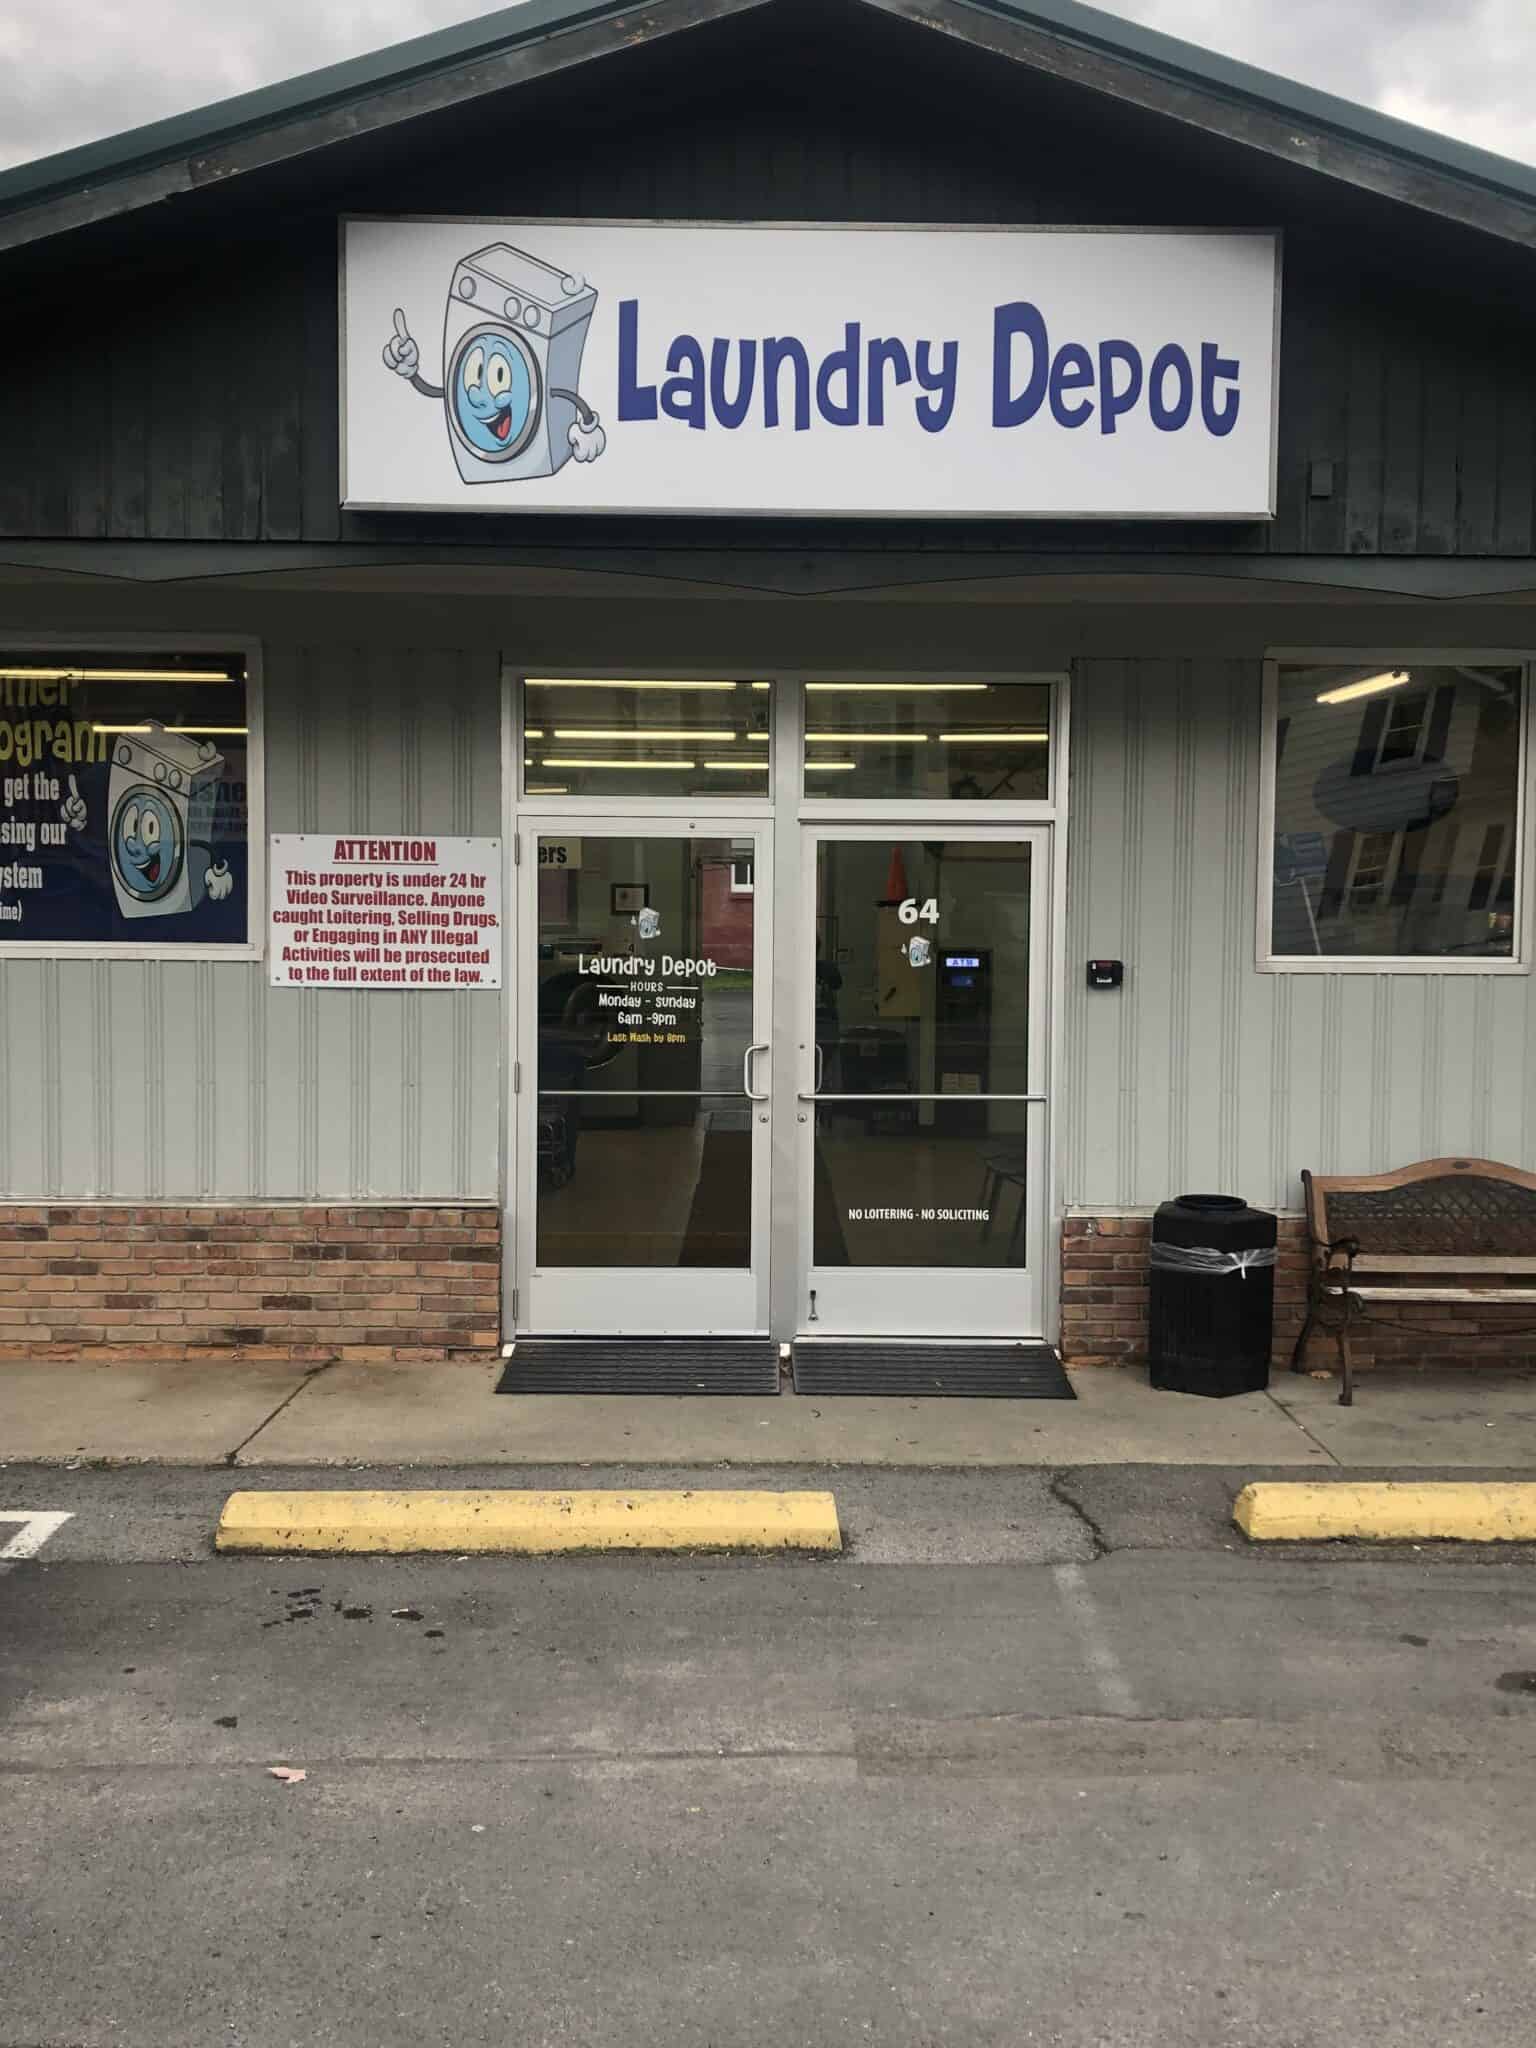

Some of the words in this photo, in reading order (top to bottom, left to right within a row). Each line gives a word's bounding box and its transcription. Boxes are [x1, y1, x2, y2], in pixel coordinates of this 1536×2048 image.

[618, 300, 958, 434] Laundry
[993, 301, 1241, 437] Depot
[0, 667, 79, 706] mer
[4, 773, 29, 807] get
[34, 771, 60, 800] the
[1, 816, 36, 851] sing
[40, 822, 67, 845] our
[333, 840, 437, 862] ATTENTION
[286, 870, 316, 885] This
[320, 872, 382, 888] property
[386, 872, 399, 887] is
[403, 873, 446, 888] under
[450, 873, 467, 888] 24
[471, 874, 486, 888] hr
[287, 889, 328, 905] Video
[332, 890, 428, 906] Surveillance.
[431, 891, 486, 908] Anyone
[272, 909, 323, 925] caught
[398, 910, 450, 927] Selling
[898, 899, 939, 924] 64
[293, 930, 309, 943] or
[312, 928, 379, 945] Engaging
[383, 929, 397, 944] in
[400, 929, 428, 944] ANY
[431, 930, 478, 946] Illegal
[282, 946, 350, 962] Activities
[354, 948, 380, 962] will
[384, 948, 401, 963] be
[405, 949, 489, 964] prosecuted
[288, 966, 303, 981] to
[306, 966, 330, 981] the
[333, 967, 357, 981] full
[361, 968, 406, 982] extent
[410, 968, 424, 982] of
[428, 968, 451, 982] the
[455, 968, 483, 983] law.
[578, 954, 655, 976] Laundry
[662, 956, 717, 977] Depot
[630, 981, 664, 992] HOURS
[599, 993, 641, 1007] Monday
[618, 1011, 643, 1025] 6am
[607, 1032, 627, 1042] Last
[629, 1032, 652, 1043] Wash
[654, 1033, 665, 1043] by
[848, 1209, 863, 1220] NO
[864, 1209, 914, 1220] LOITERING
[921, 1209, 935, 1220] NO
[937, 1209, 990, 1220] SOLICITING
